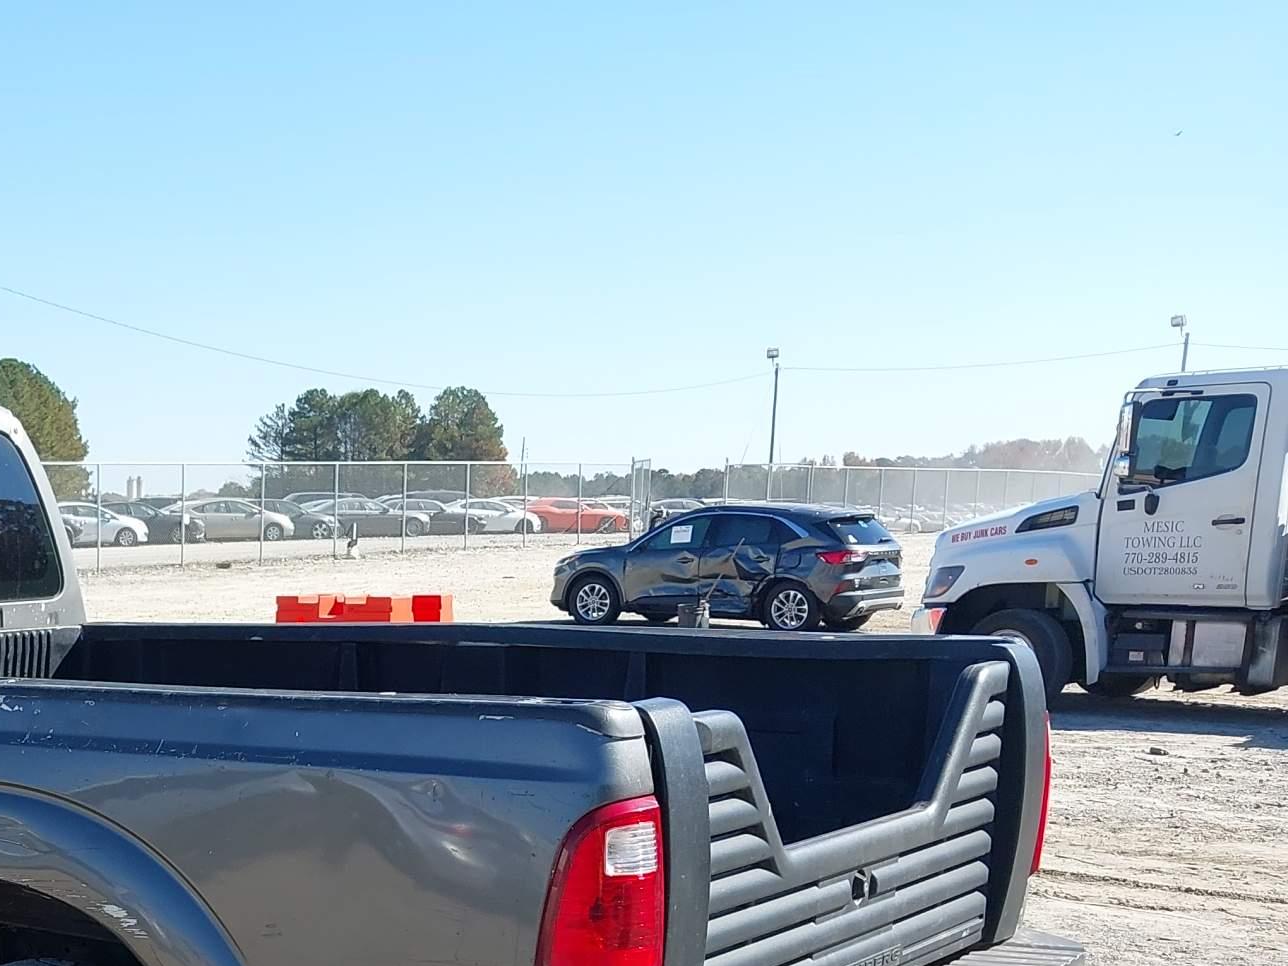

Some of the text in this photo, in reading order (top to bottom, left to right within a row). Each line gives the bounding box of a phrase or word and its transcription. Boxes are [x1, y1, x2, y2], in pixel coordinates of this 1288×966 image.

[1143, 520, 1185, 533] MESIC
[952, 526, 1007, 543] WE BUY JUNK CARS
[1124, 535, 1202, 548] TOWING LLC
[1124, 551, 1199, 564] 770-289-4815
